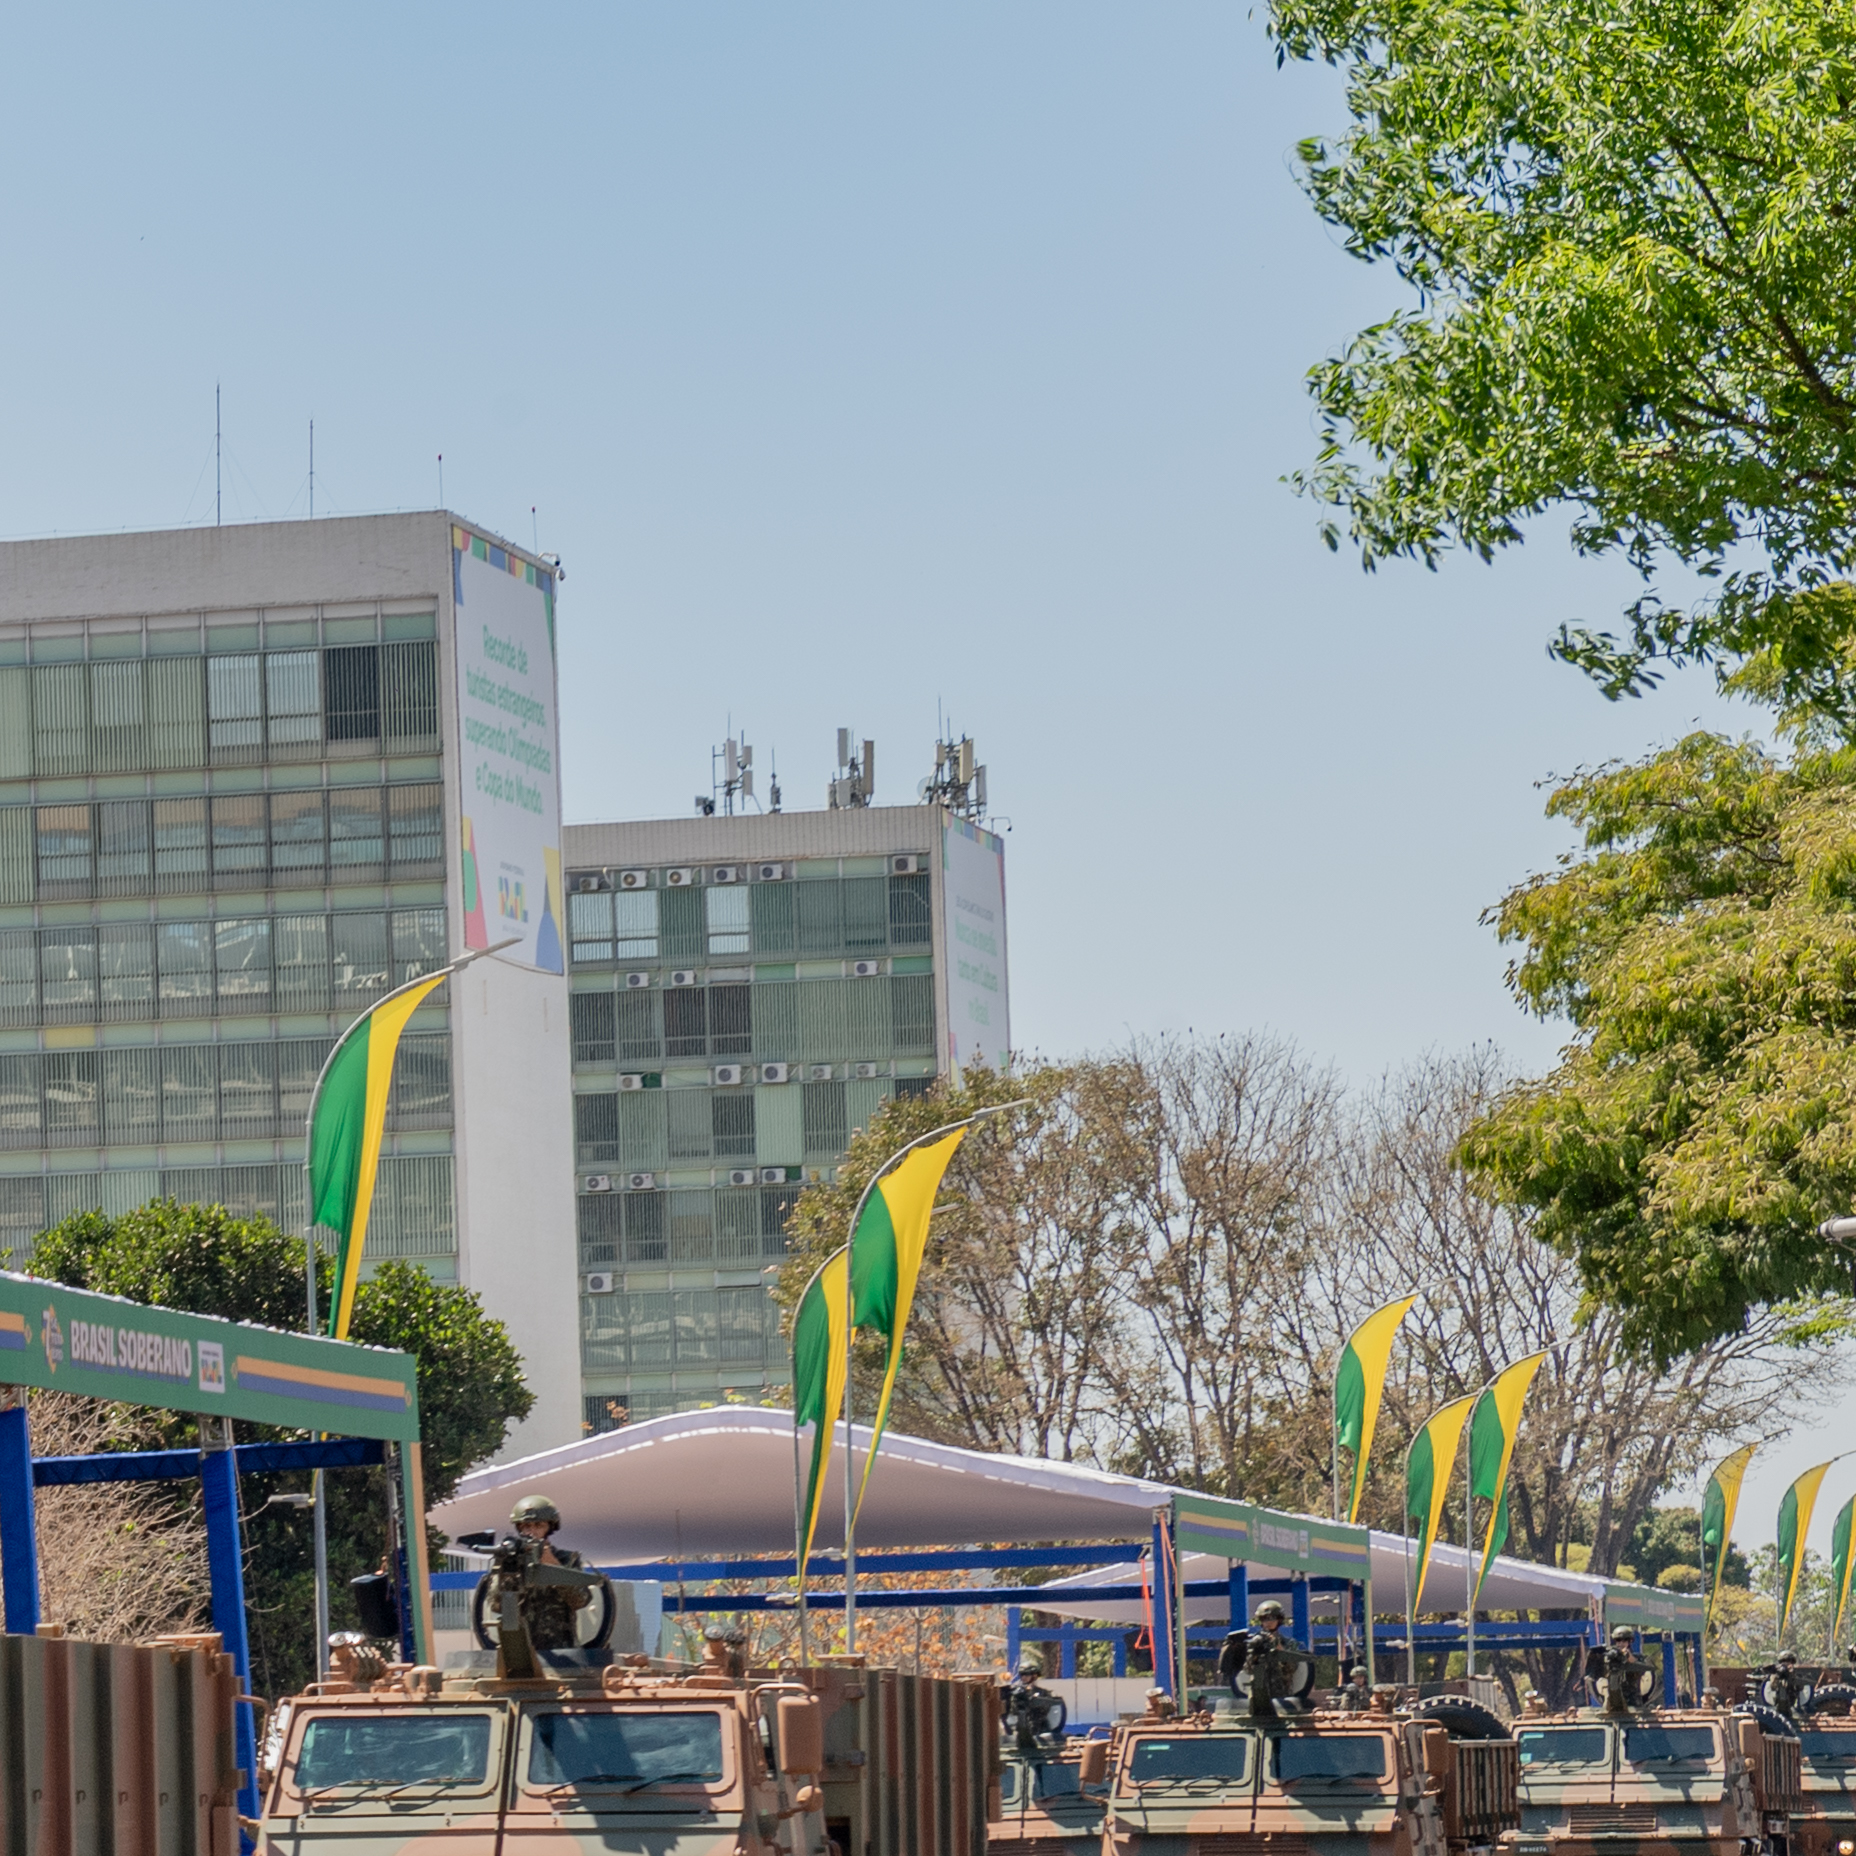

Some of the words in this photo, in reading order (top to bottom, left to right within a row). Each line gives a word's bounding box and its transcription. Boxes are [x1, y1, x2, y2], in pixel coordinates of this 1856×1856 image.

[483, 624, 516, 670] Recorde
[517, 640, 528, 676] de
[476, 765, 482, 791] e
[483, 761, 503, 807] Copa
[505, 769, 515, 804] do
[71, 1319, 118, 1367] BRASIL
[118, 1328, 192, 1378] SOBERANO
